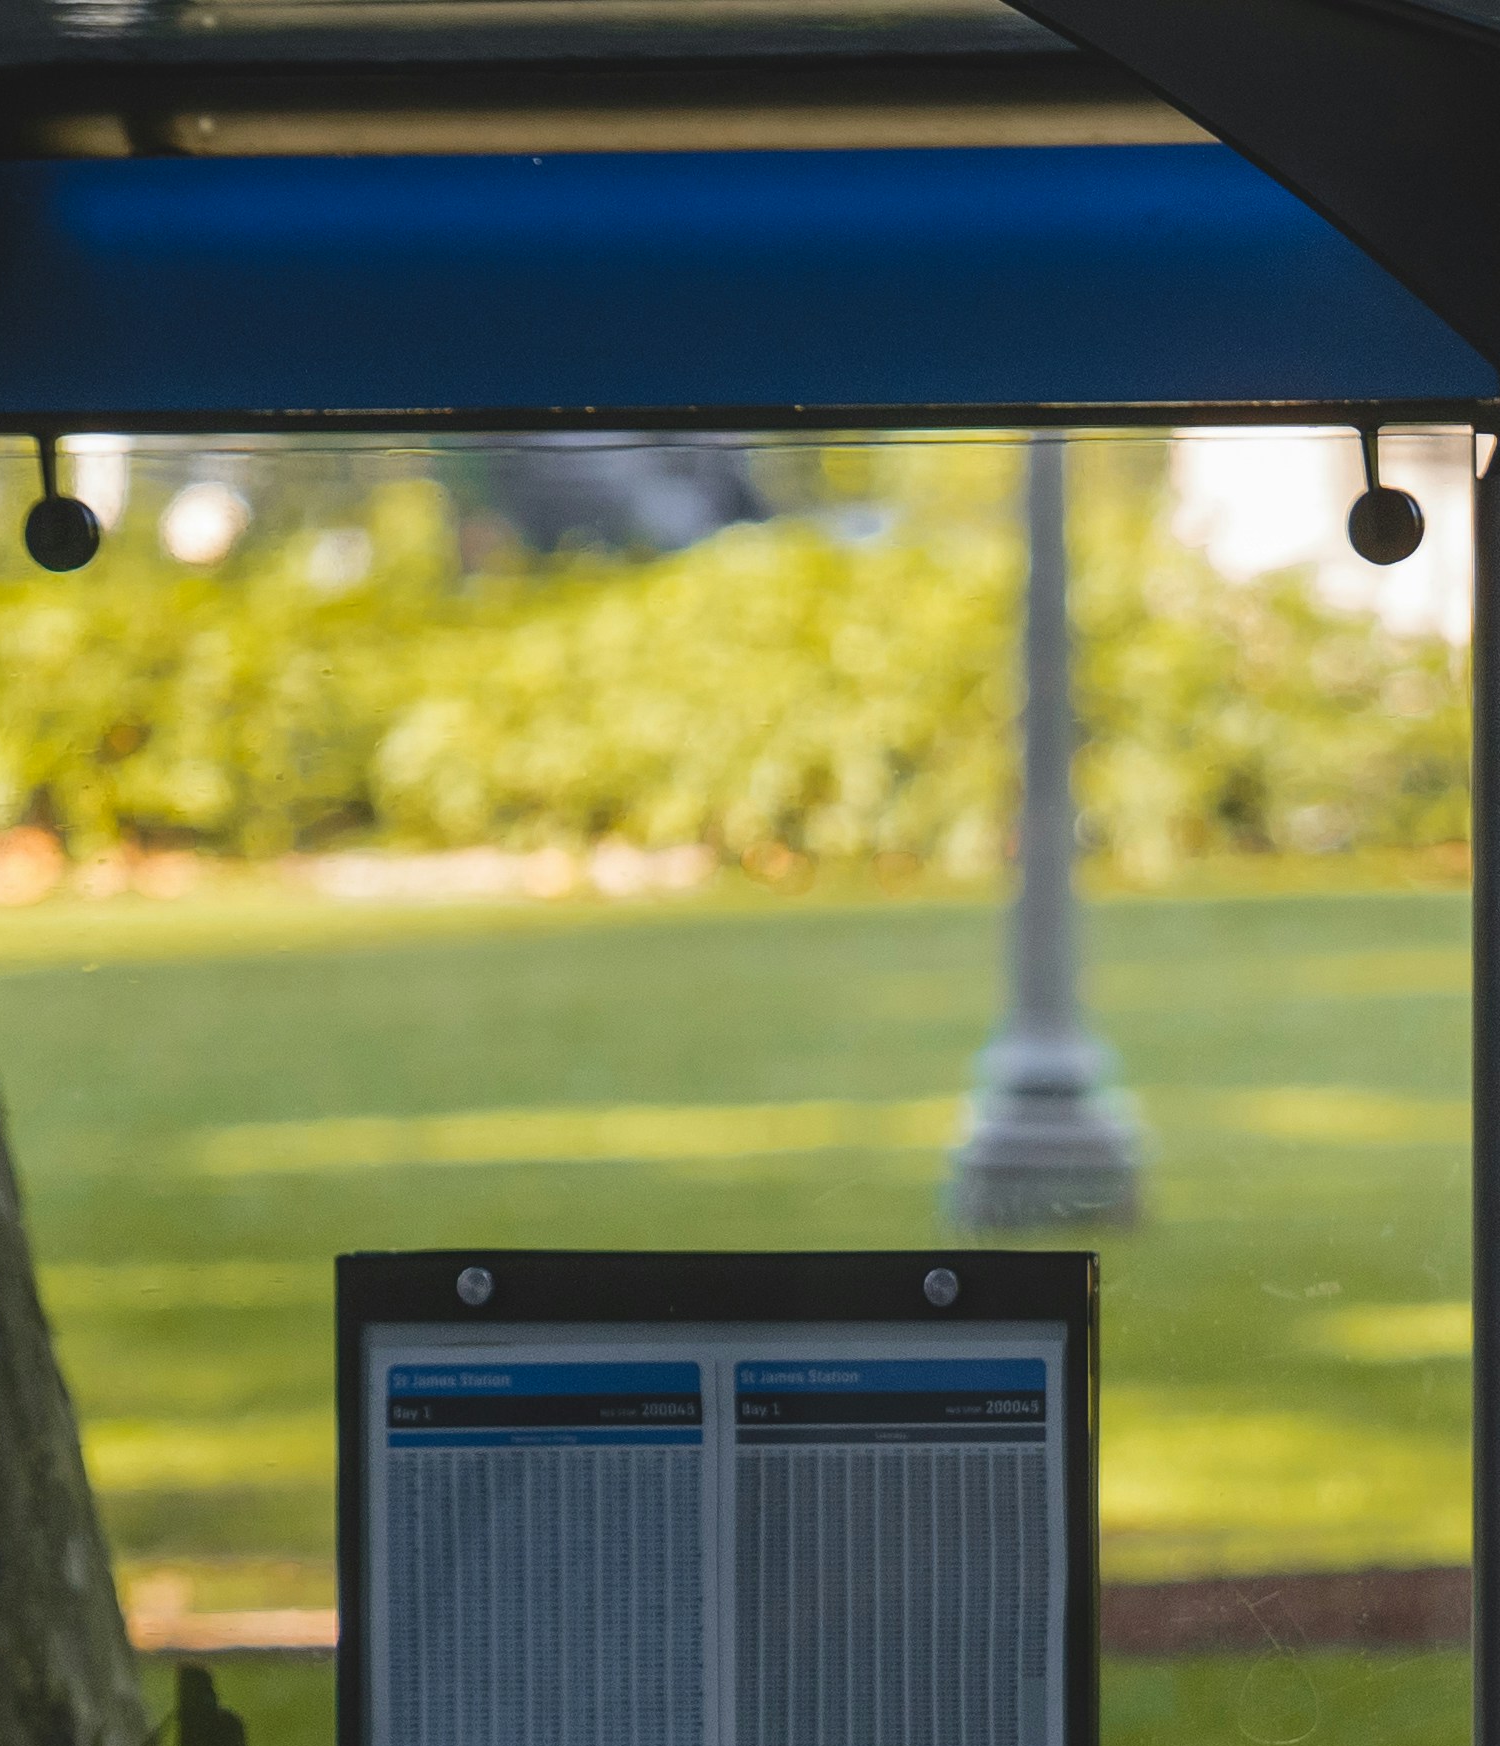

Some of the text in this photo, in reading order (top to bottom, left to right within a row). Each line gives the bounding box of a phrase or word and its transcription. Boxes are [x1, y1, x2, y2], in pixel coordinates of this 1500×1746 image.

[393, 1373, 513, 1387] St James Station
[741, 1369, 859, 1384] St James Station
[393, 1406, 431, 1421] Bay 1
[742, 1402, 781, 1417] Bay 1
[986, 1400, 1040, 1414] 200045
